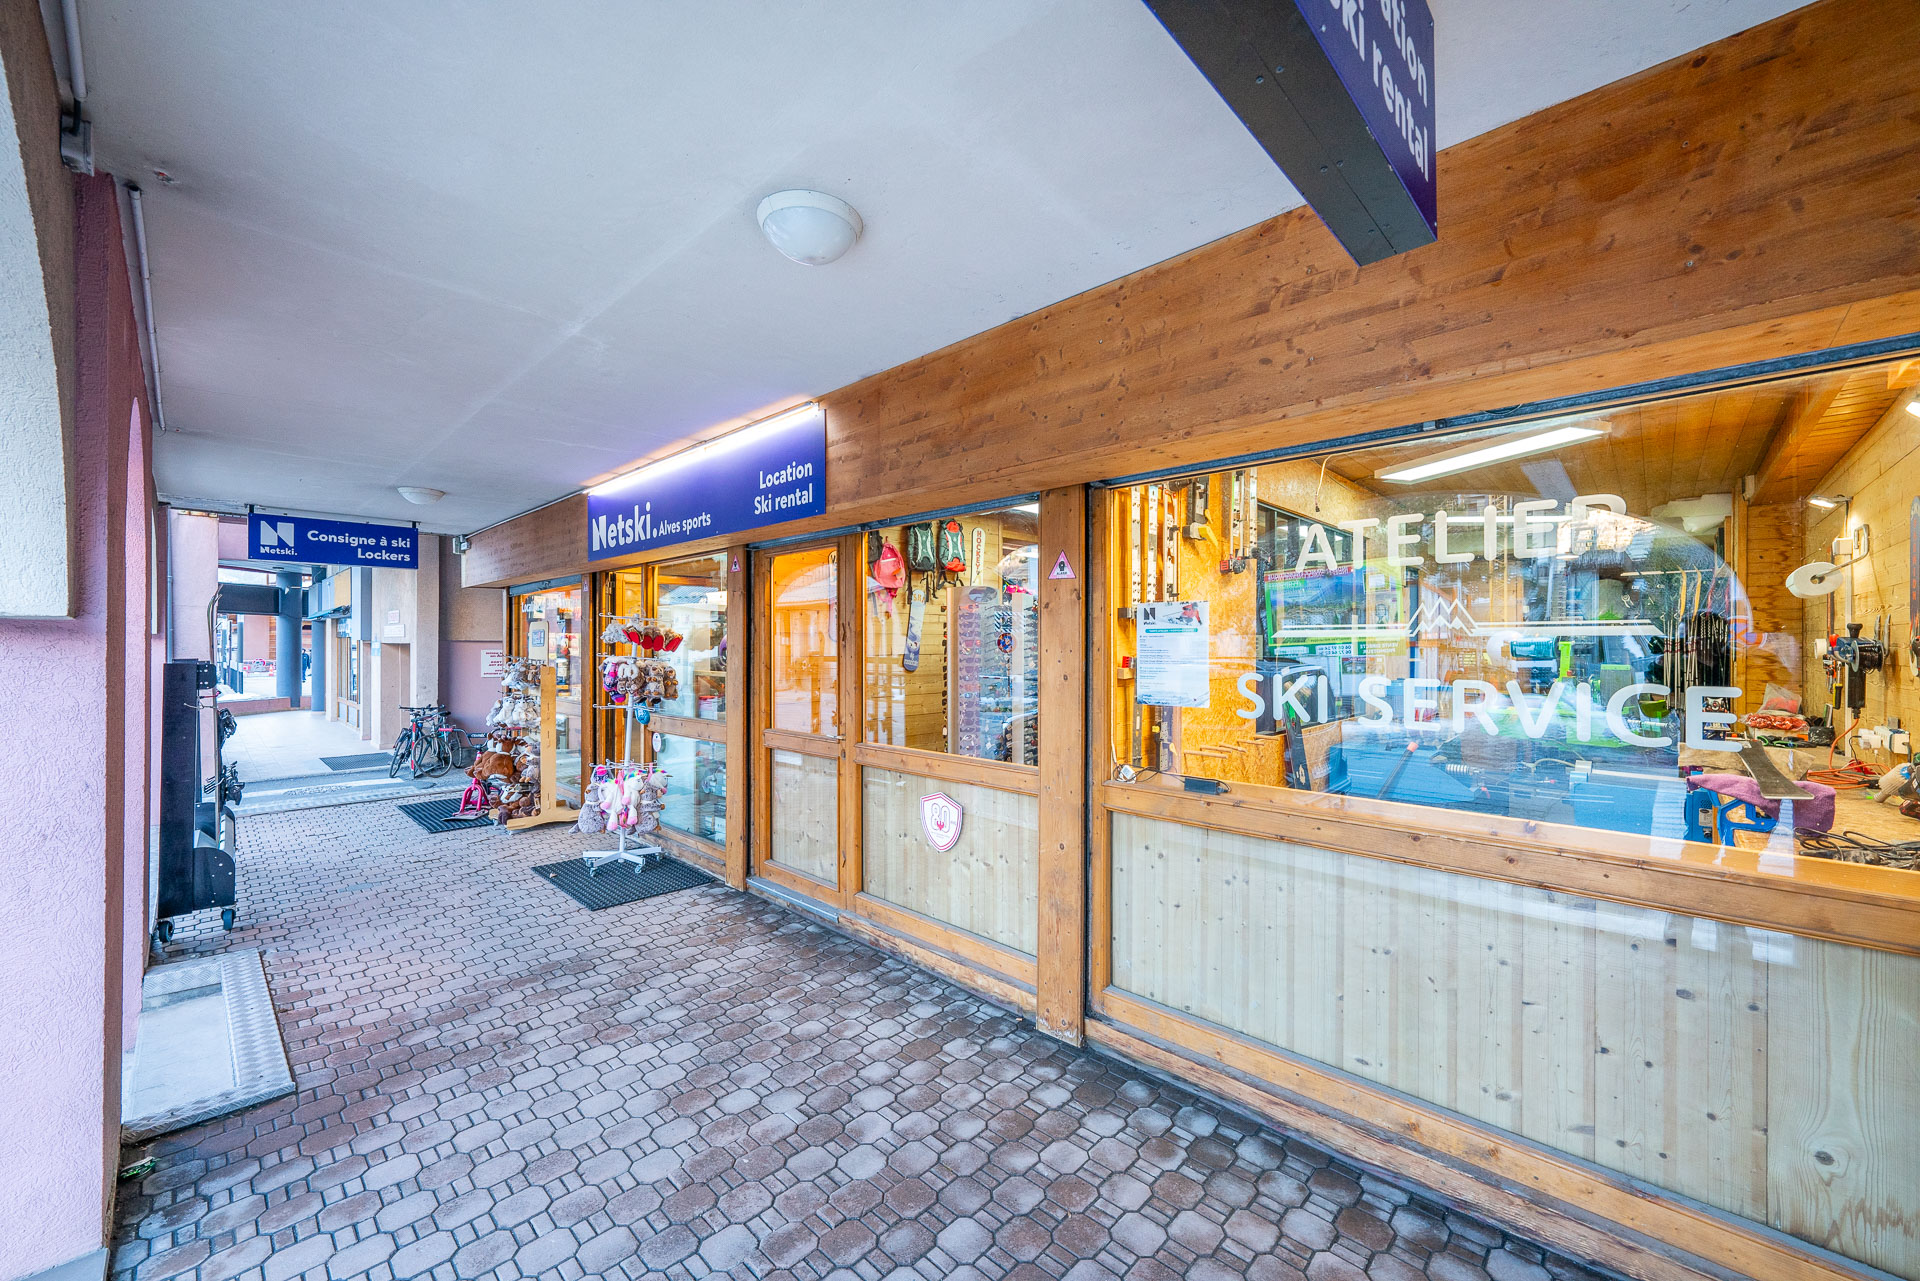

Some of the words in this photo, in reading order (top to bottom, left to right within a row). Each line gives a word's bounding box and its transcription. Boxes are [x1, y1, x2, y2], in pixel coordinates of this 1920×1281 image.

[1377, 0, 1428, 108] ation
[1372, 39, 1429, 183] rental
[759, 461, 813, 489] Location
[754, 495, 772, 515] Ski
[775, 483, 813, 511] rental
[307, 530, 376, 547] Consigne
[379, 536, 388, 547] à
[391, 538, 411, 548] ski
[659, 520, 681, 537] Alves
[682, 511, 711, 536] sports
[1294, 493, 1628, 573] ATELIER
[357, 548, 411, 562] Lockers
[1236, 672, 1329, 724] SKI
[1358, 675, 1744, 753] SERVICE
